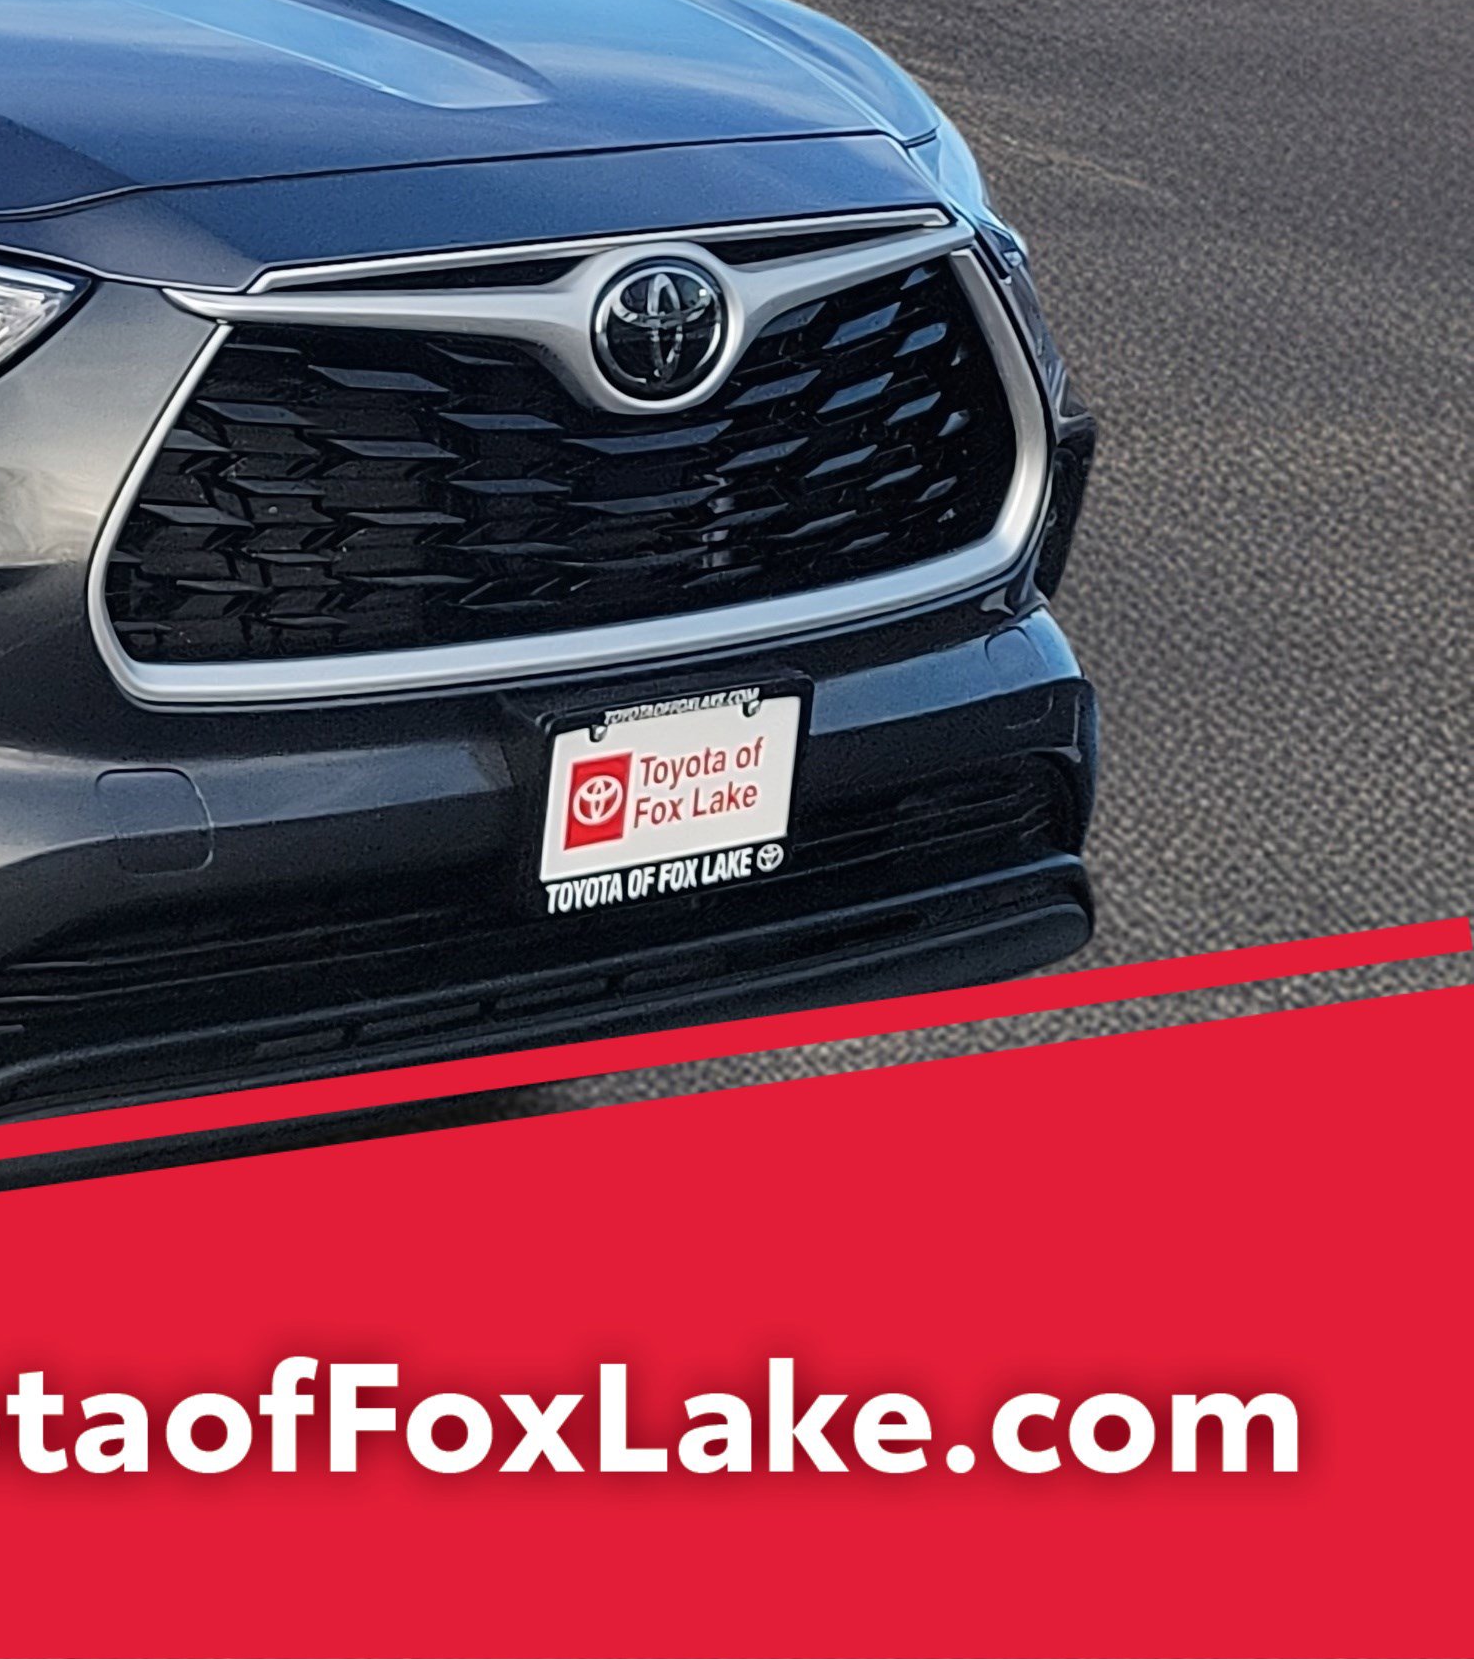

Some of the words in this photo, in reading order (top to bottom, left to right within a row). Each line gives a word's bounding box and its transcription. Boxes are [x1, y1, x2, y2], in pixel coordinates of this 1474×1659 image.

[639, 746, 727, 791] Toyota
[735, 735, 765, 769] of
[633, 797, 684, 829] Fox
[692, 780, 759, 819] Lake
[545, 872, 624, 914] TOYOTA
[627, 866, 656, 901] OF
[657, 857, 699, 894] FOX
[702, 847, 754, 886] LAKE
